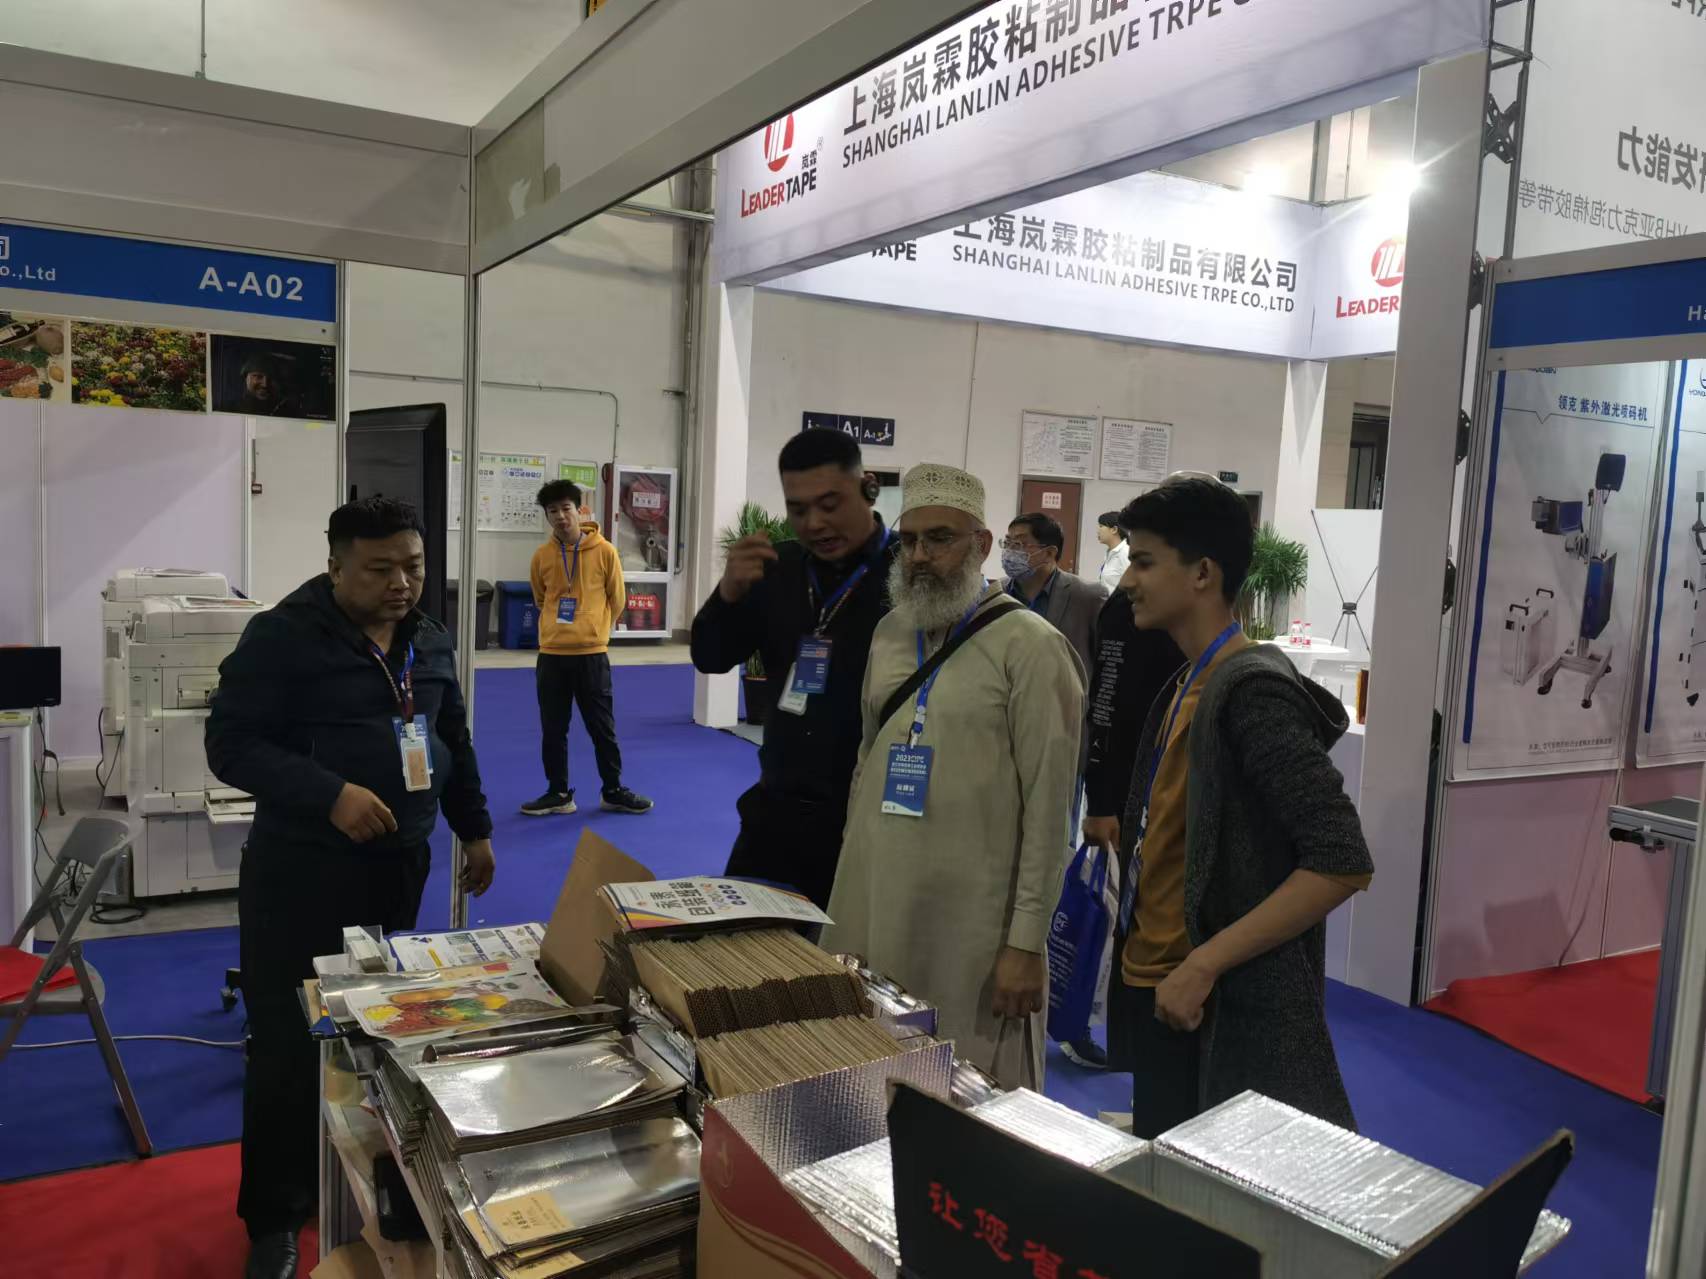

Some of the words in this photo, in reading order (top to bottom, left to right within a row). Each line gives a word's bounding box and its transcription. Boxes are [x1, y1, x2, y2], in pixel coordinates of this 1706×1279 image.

[843, 110, 930, 168] SHANGHAI
[936, 76, 1009, 130] LANLIN
[1016, 18, 1140, 97] ADHESIVE
[1149, 0, 1222, 40] TRPE
[199, 266, 304, 301] A-A02
[953, 244, 1050, 276] SHANGHAI
[1055, 261, 1116, 287] LANLIN
[1120, 272, 1198, 299] ADHESIVE
[1202, 285, 1237, 304] TRPE
[1241, 291, 1295, 313] CO.,LTD
[1336, 295, 1399, 318] LEADER
